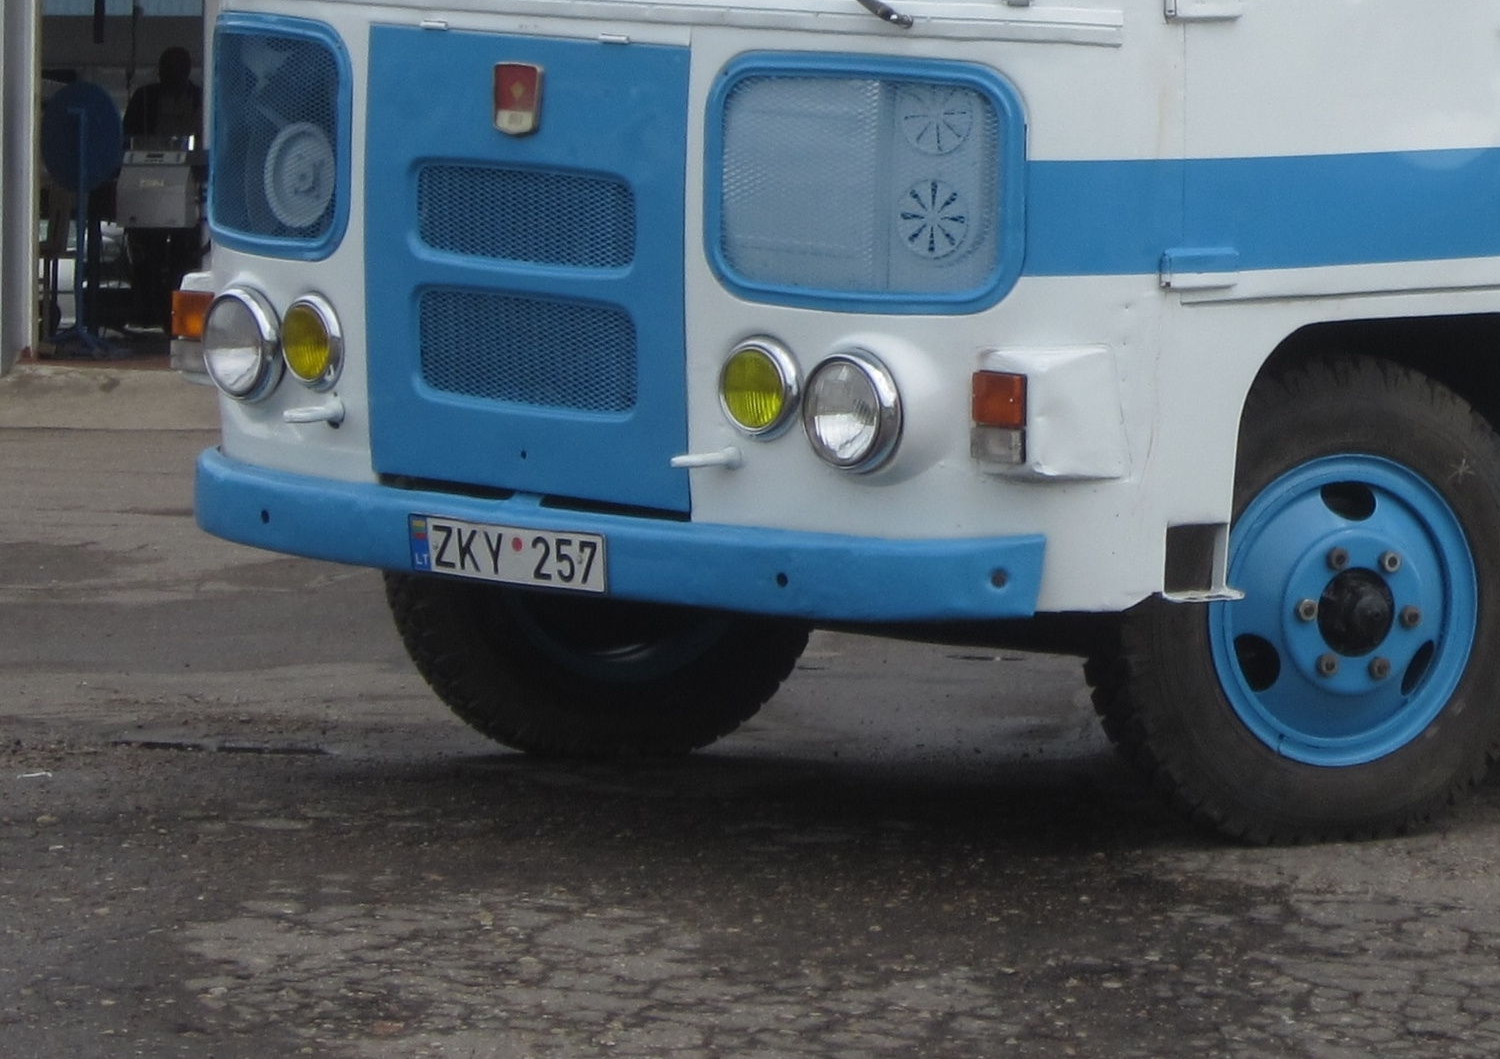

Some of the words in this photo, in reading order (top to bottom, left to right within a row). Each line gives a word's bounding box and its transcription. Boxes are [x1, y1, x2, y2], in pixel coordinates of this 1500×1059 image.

[414, 553, 429, 566] LT
[432, 524, 503, 575] ZKY
[531, 536, 597, 584] 257
